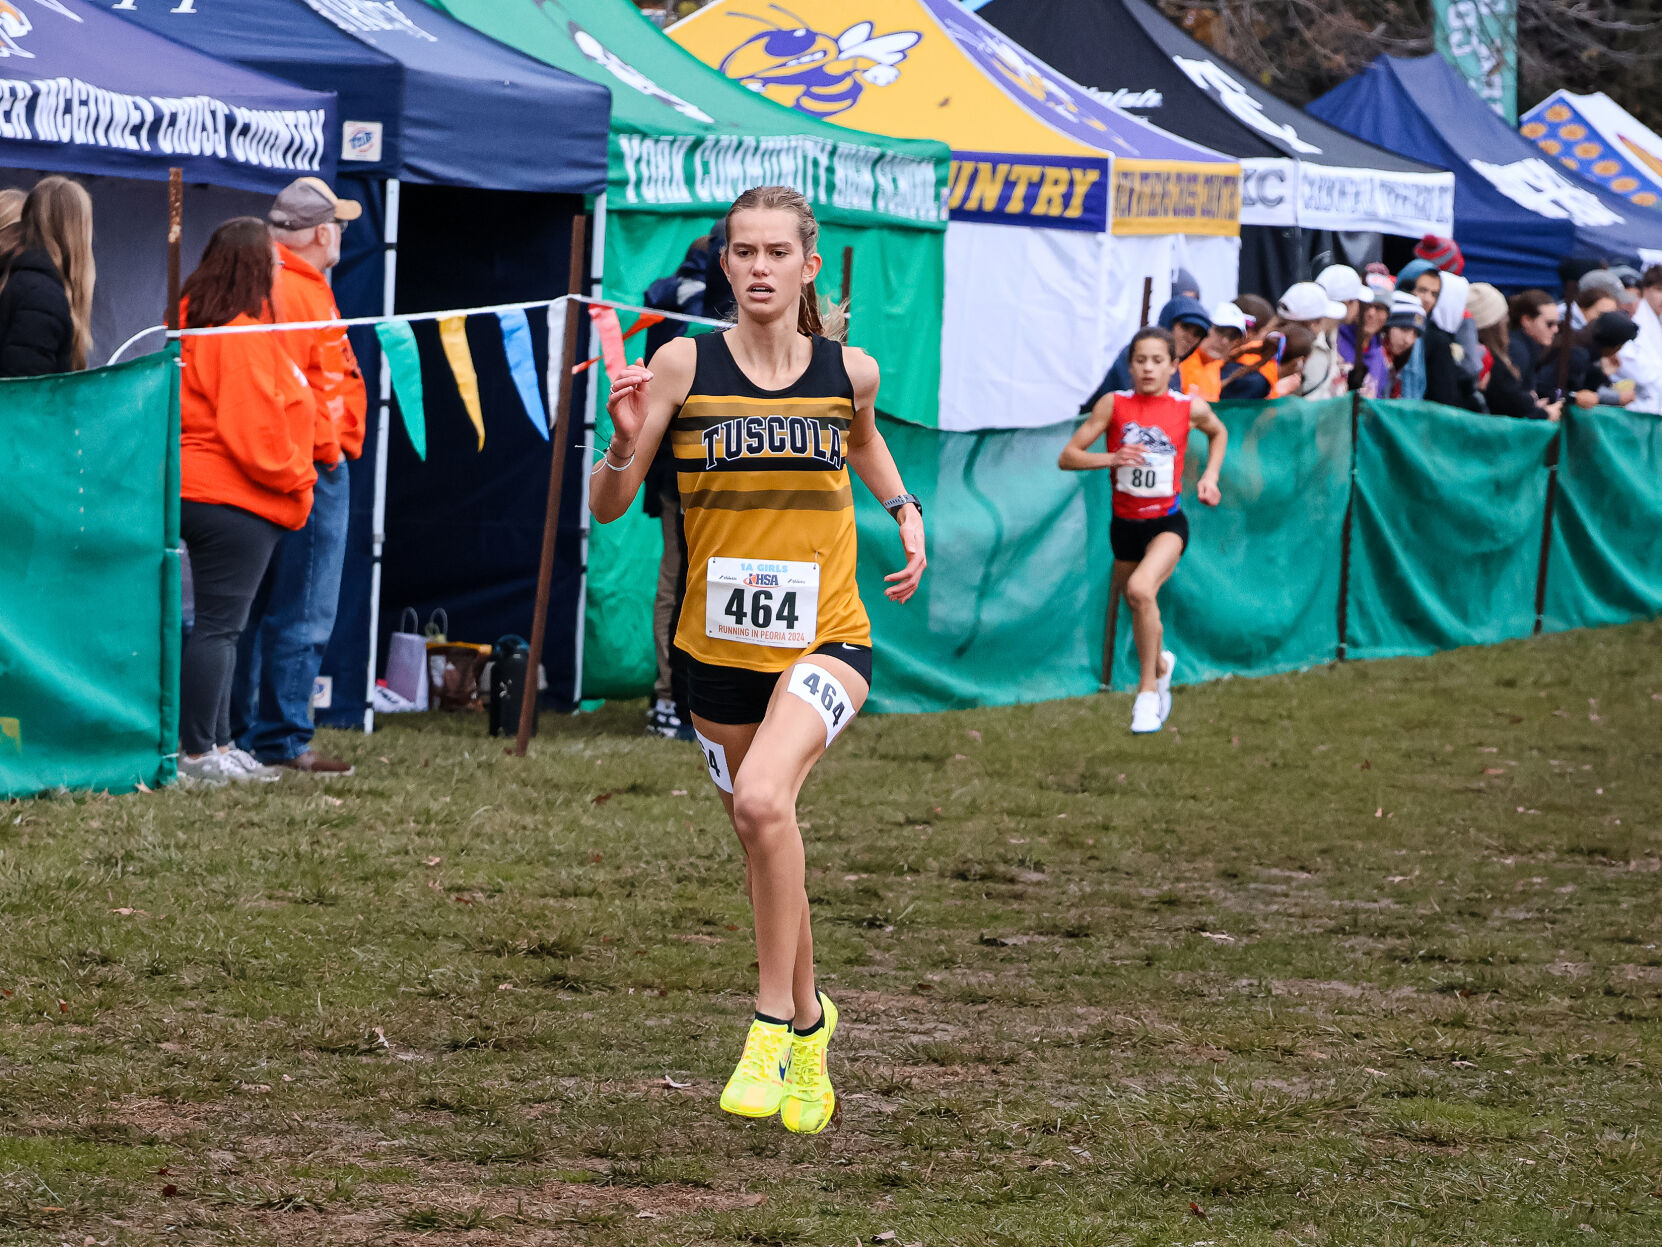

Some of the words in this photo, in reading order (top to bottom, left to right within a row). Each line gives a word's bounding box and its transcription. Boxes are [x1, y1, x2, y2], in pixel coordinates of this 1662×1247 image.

[150, 95, 230, 158] CROSS
[229, 104, 325, 171] COUNTRY
[619, 134, 695, 203] YORK
[694, 134, 833, 204] COMMUNITY
[948, 160, 1100, 218] UNTRY
[702, 415, 843, 470] TUSCOLA
[1132, 468, 1156, 488] 80
[740, 563, 754, 571] 1A
[757, 564, 788, 573] GIRLS
[718, 624, 750, 637] RUNNING
[751, 629, 759, 638] IN
[760, 630, 786, 641] PEORIA
[788, 632, 805, 642] 2024
[725, 588, 799, 629] 464
[803, 672, 845, 728] 464
